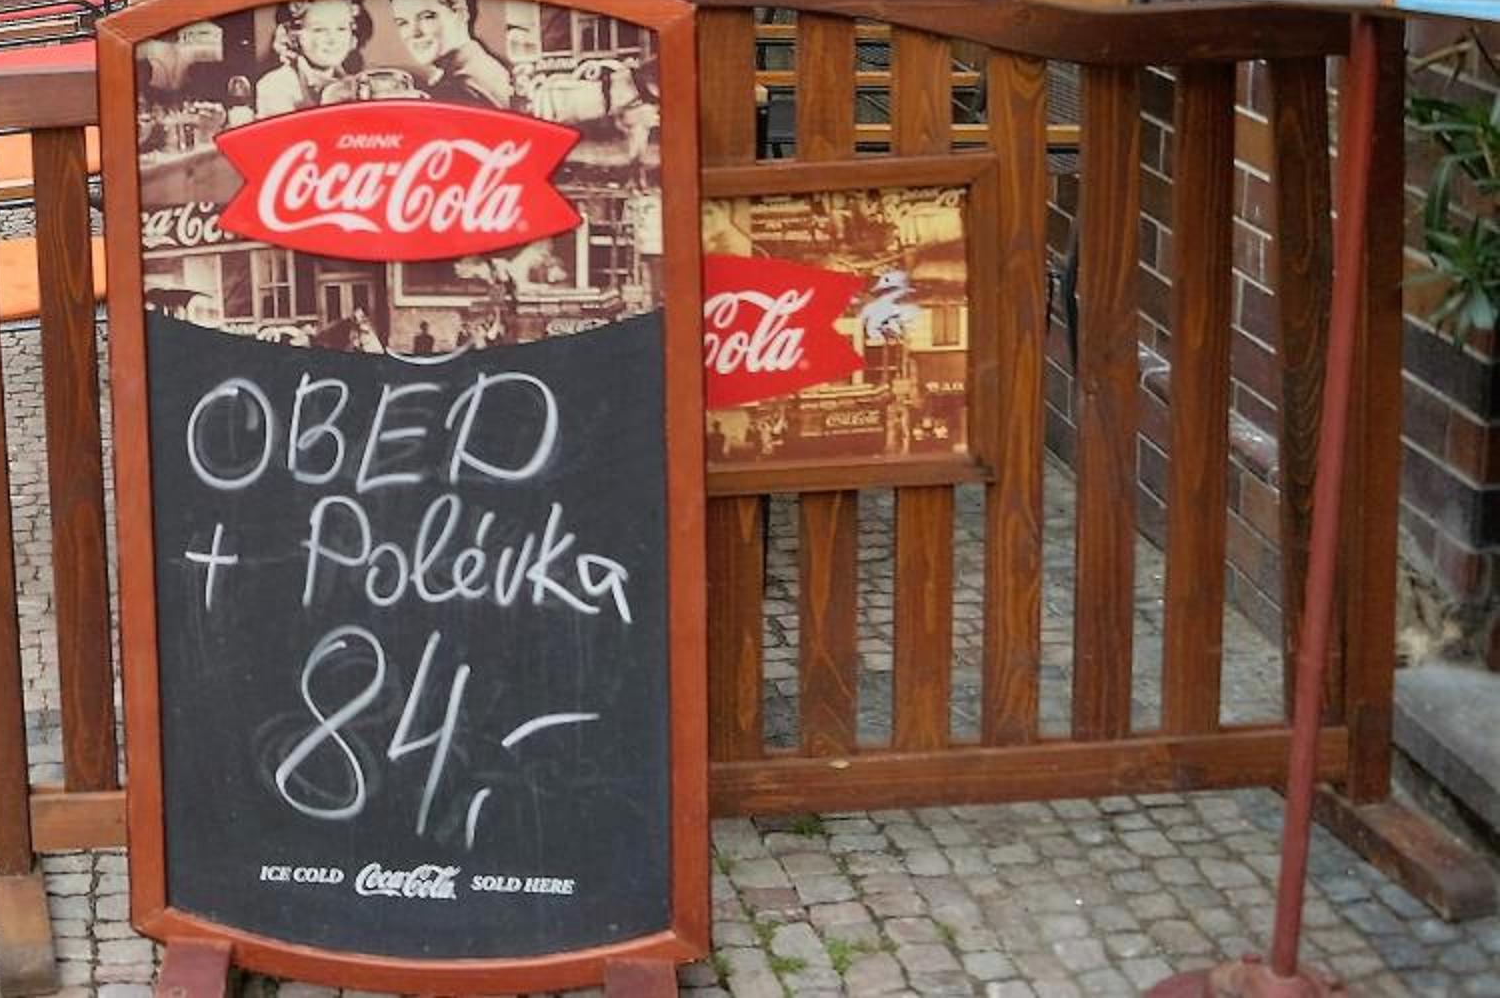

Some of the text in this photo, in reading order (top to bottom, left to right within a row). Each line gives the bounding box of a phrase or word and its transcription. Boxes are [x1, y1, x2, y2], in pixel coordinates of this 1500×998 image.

[336, 133, 403, 150] DRINK
[257, 138, 533, 234] Coca-Cola
[259, 864, 291, 881] ICE
[293, 866, 344, 884] COLD
[471, 874, 522, 893] SOLD
[523, 876, 575, 895] HERE
